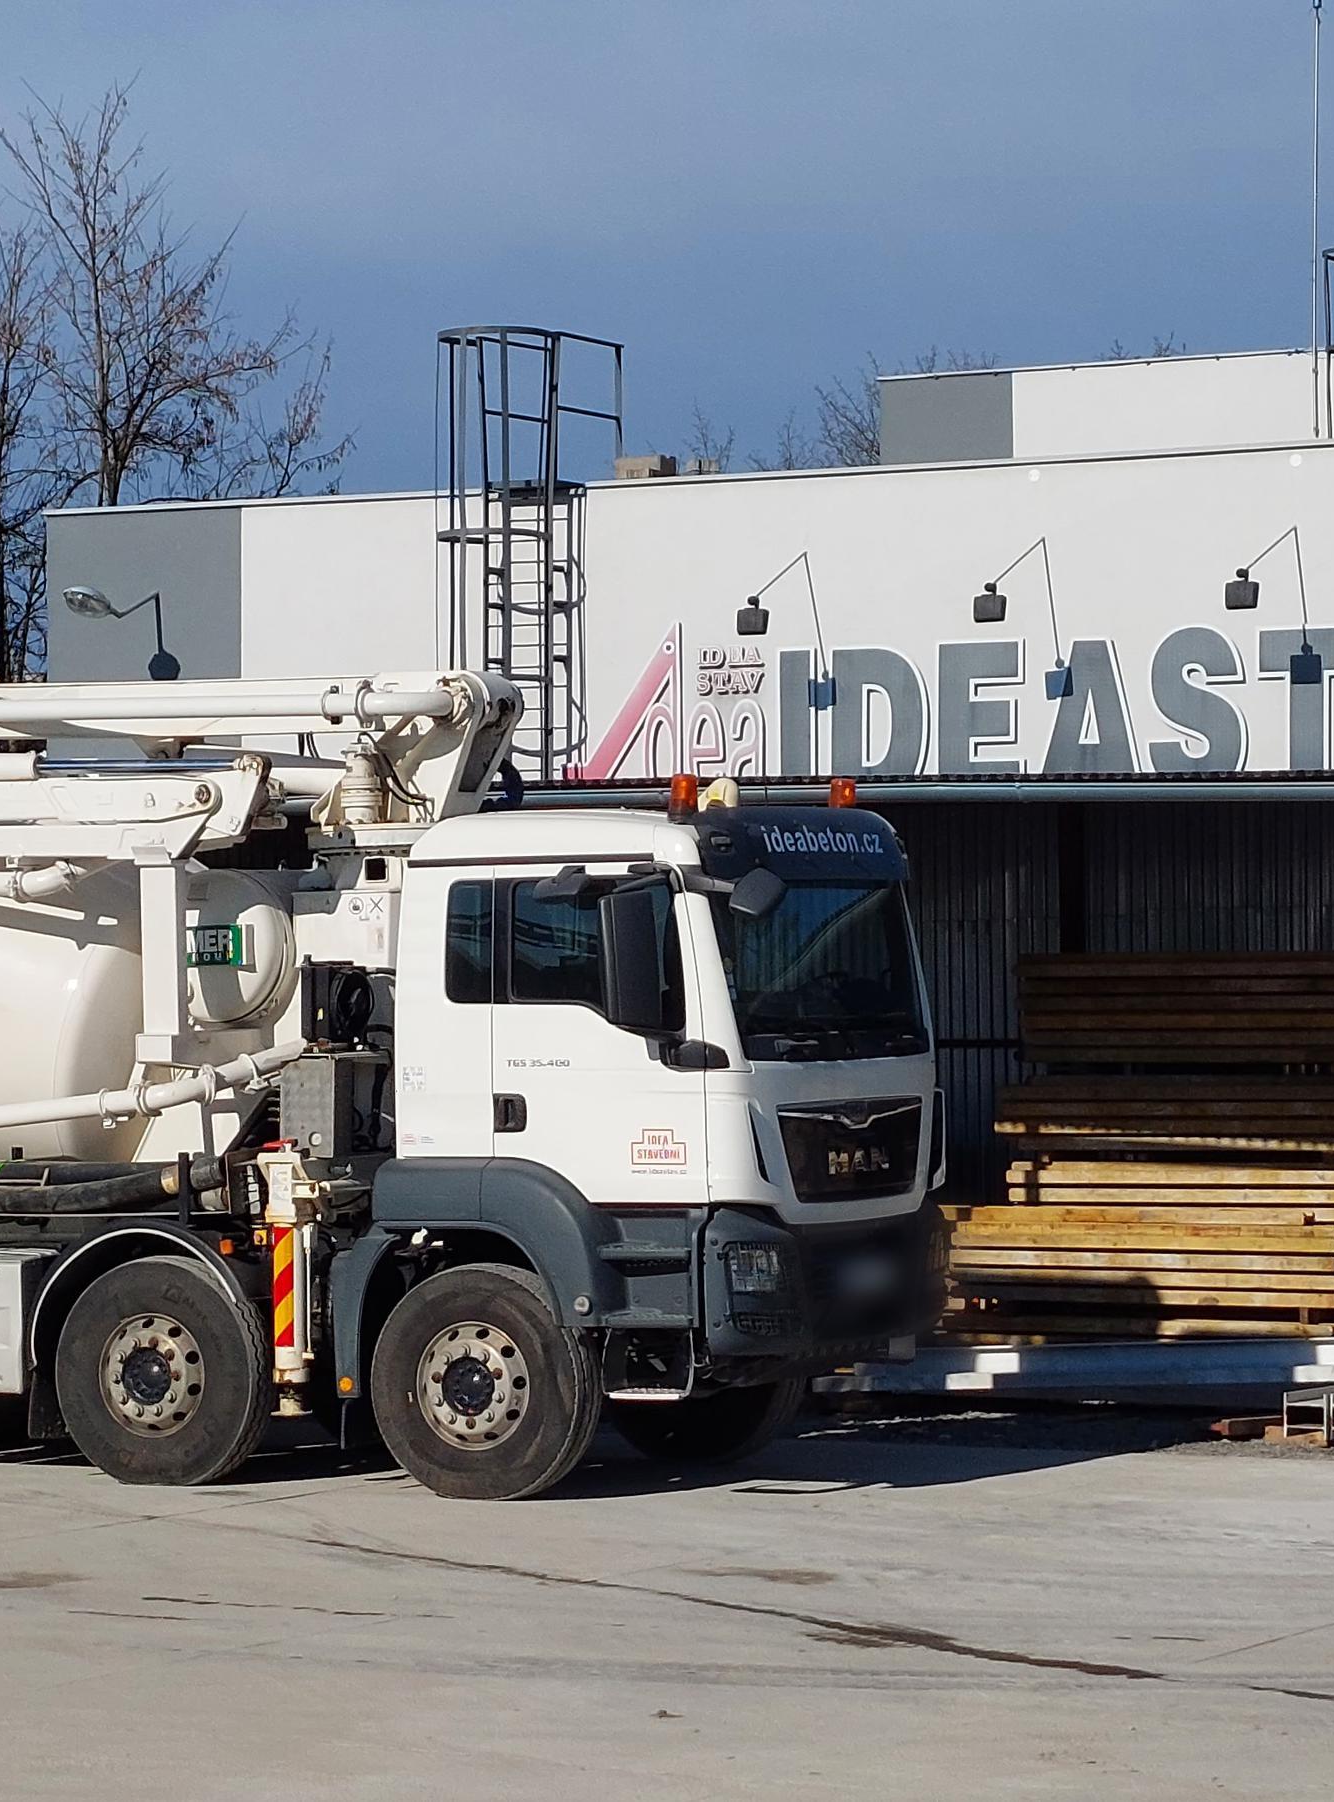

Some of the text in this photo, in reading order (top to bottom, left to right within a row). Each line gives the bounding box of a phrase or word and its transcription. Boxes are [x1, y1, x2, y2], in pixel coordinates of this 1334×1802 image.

[697, 647, 765, 668] IDEA
[696, 671, 765, 696] STAV
[760, 825, 884, 853] ideabeton.cz
[186, 929, 233, 953] MER
[828, 1147, 889, 1175] MAN
